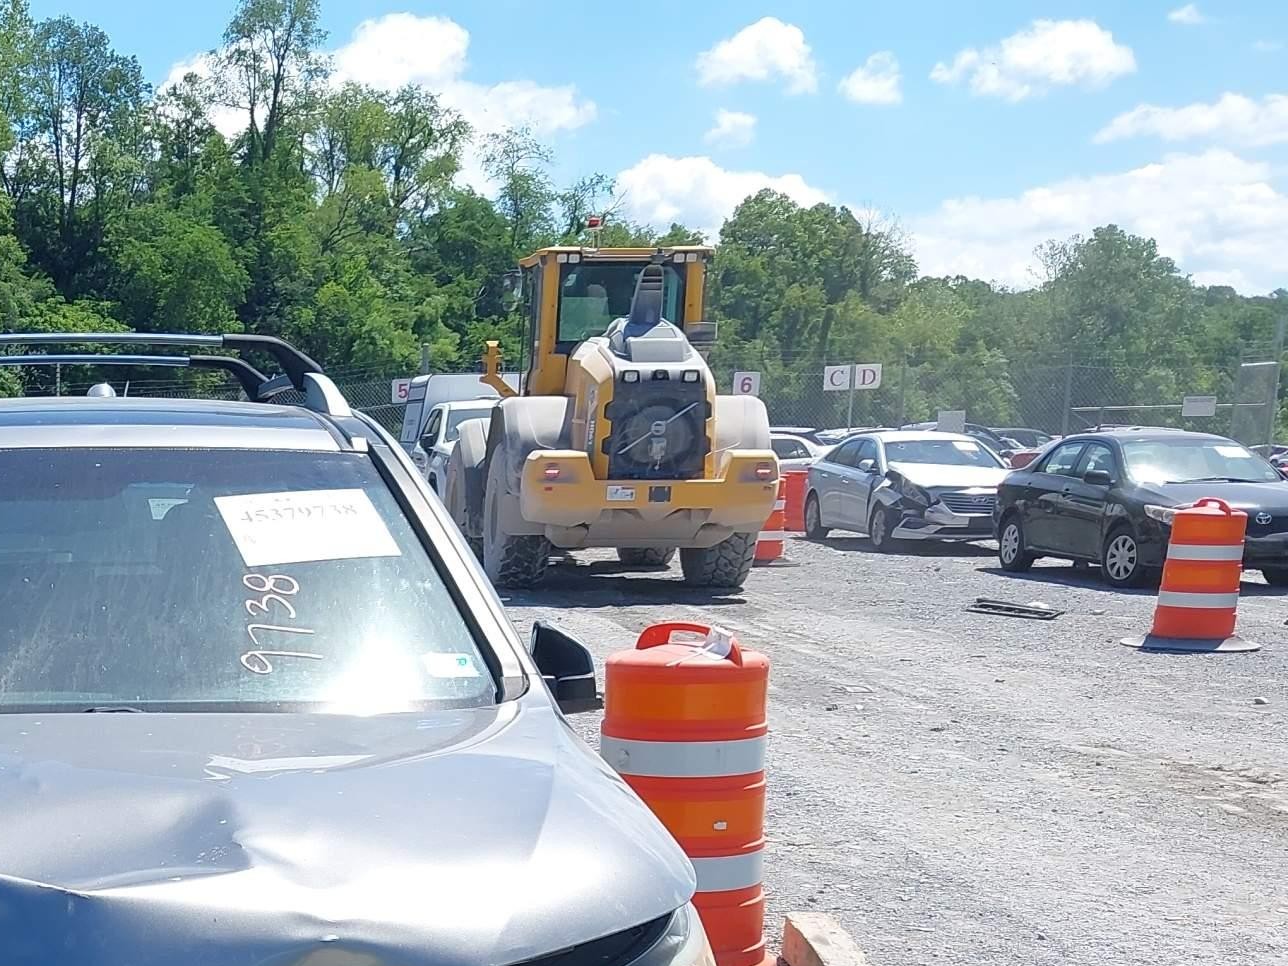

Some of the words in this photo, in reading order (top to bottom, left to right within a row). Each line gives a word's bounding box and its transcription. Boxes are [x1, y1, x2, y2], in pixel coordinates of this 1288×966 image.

[740, 377, 753, 394] 6
[829, 369, 845, 387] C
[859, 368, 877, 386] D
[398, 383, 409, 399] 5
[240, 572, 324, 675] 9738
